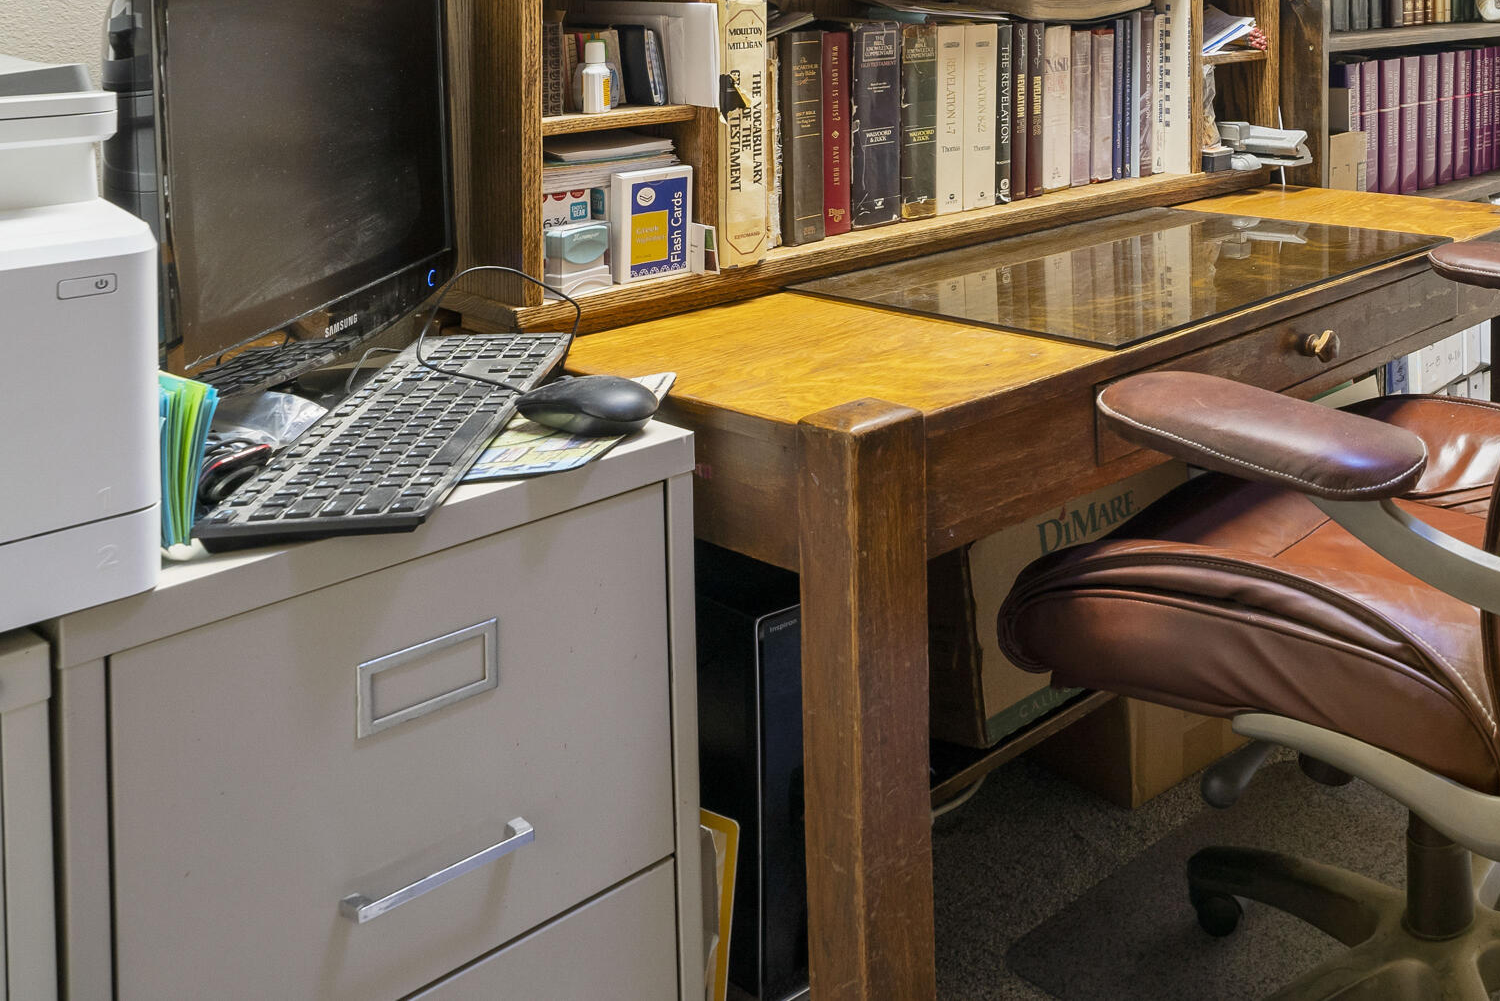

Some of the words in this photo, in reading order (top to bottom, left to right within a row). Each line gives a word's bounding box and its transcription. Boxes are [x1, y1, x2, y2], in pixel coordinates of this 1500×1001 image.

[728, 27, 762, 37] MOULTON
[728, 41, 763, 51] MILLIGAN
[831, 45, 839, 65] WHAT
[865, 50, 895, 58] COMMENTARY
[866, 44, 893, 52] KNOWLEDGE
[1001, 45, 1010, 68] THE
[752, 71, 762, 99] THE
[832, 89, 839, 97] IS
[946, 58, 956, 119] REVELATION
[1016, 73, 1025, 118] REVELATION
[1033, 75, 1042, 115] REVELATION
[742, 107, 752, 122] OF
[832, 100, 841, 122] THIS?
[1001, 73, 1009, 145] REVELATION
[866, 130, 892, 139] WALVOORD
[875, 135, 888, 143] ZUCK
[909, 129, 935, 138] WALVOORD
[946, 121, 956, 135] 1-7
[742, 127, 752, 152] THE
[752, 102, 762, 186] VOCABULARY
[942, 145, 961, 153] Thomas
[730, 114, 742, 193] TESTAMENT
[671, 191, 683, 226] Cards
[670, 228, 682, 264] Flash
[325, 313, 358, 338] SAMSUNG
[97, 543, 120, 569] 2
